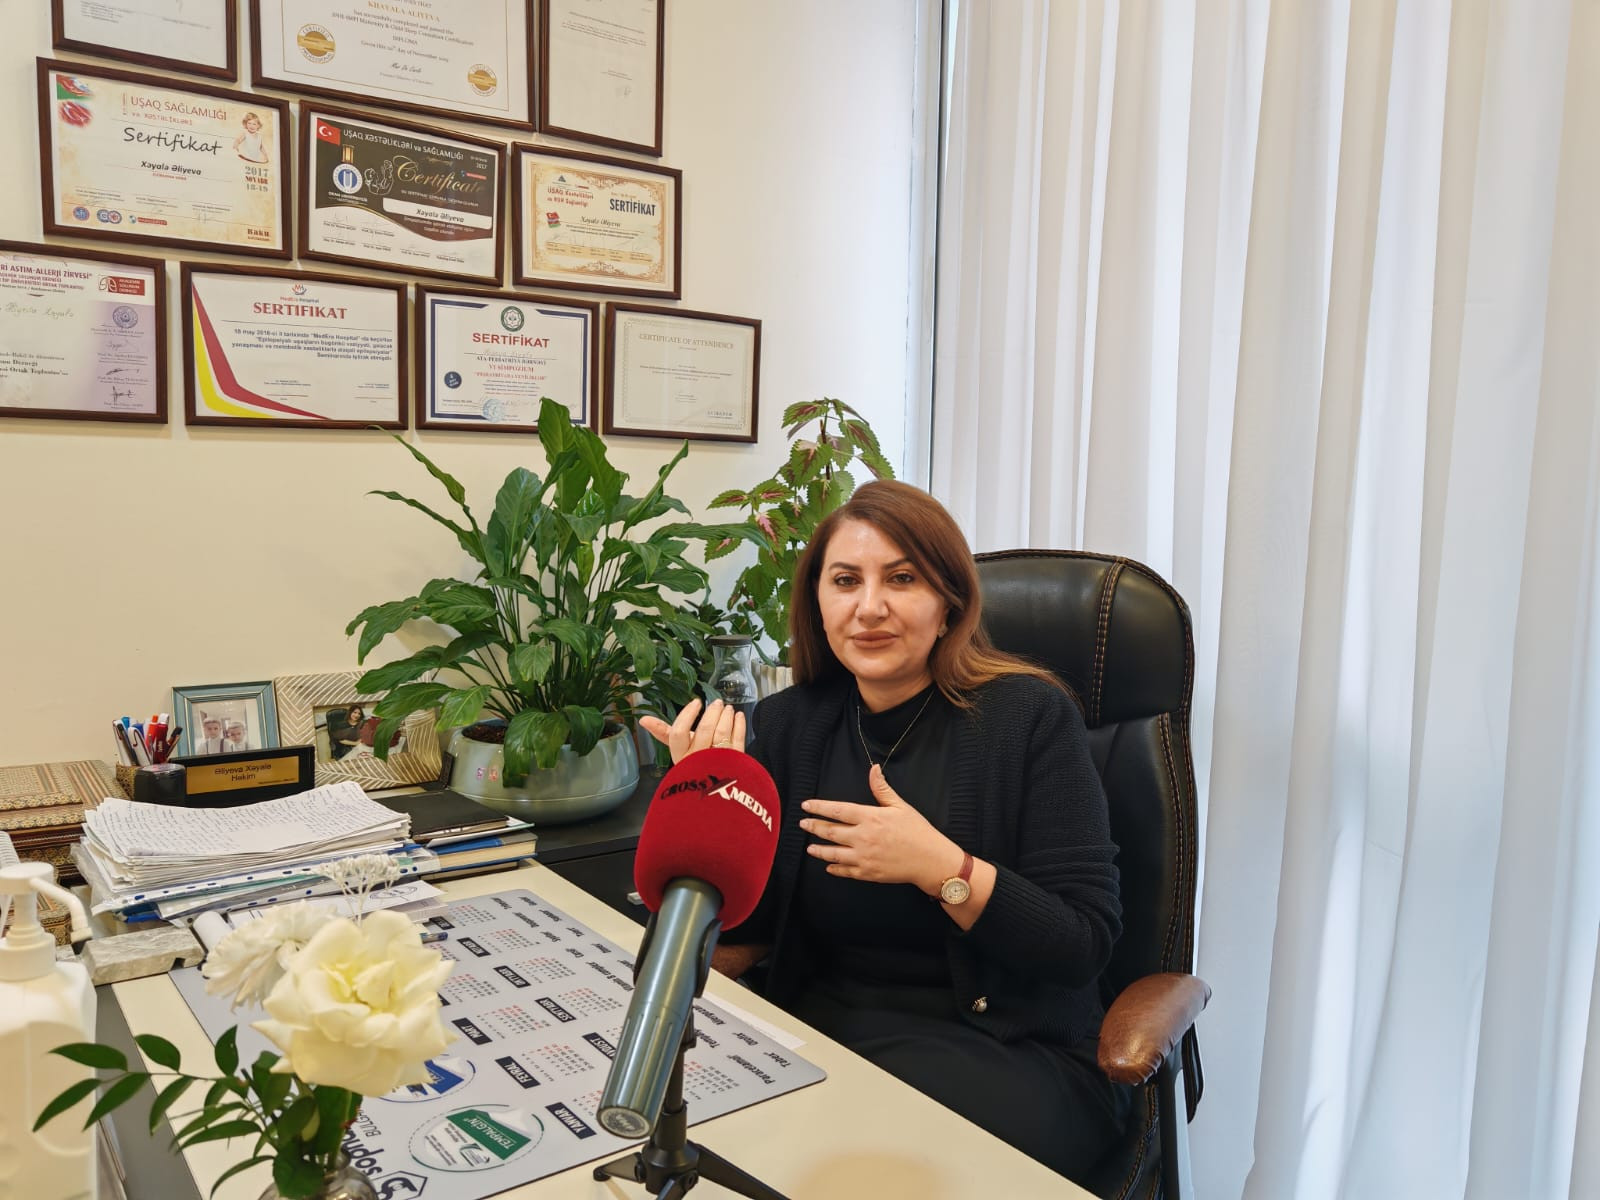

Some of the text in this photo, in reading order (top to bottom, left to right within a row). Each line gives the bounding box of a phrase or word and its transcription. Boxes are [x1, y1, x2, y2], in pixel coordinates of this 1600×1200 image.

[131, 96, 161, 111] UŞAQ
[124, 127, 222, 155] Sertifikat
[245, 166, 269, 177] 2017
[609, 197, 656, 216] SERTİFİKAT
[253, 302, 348, 320] SERTIFIKAT
[472, 333, 550, 349] SERTİFİKAT
[730, 786, 773, 832] MEDIA
[505, 1061, 530, 1083] FEVRAL
[726, 1054, 776, 1083] Paracetamol
[555, 1107, 586, 1133] YANVAR
